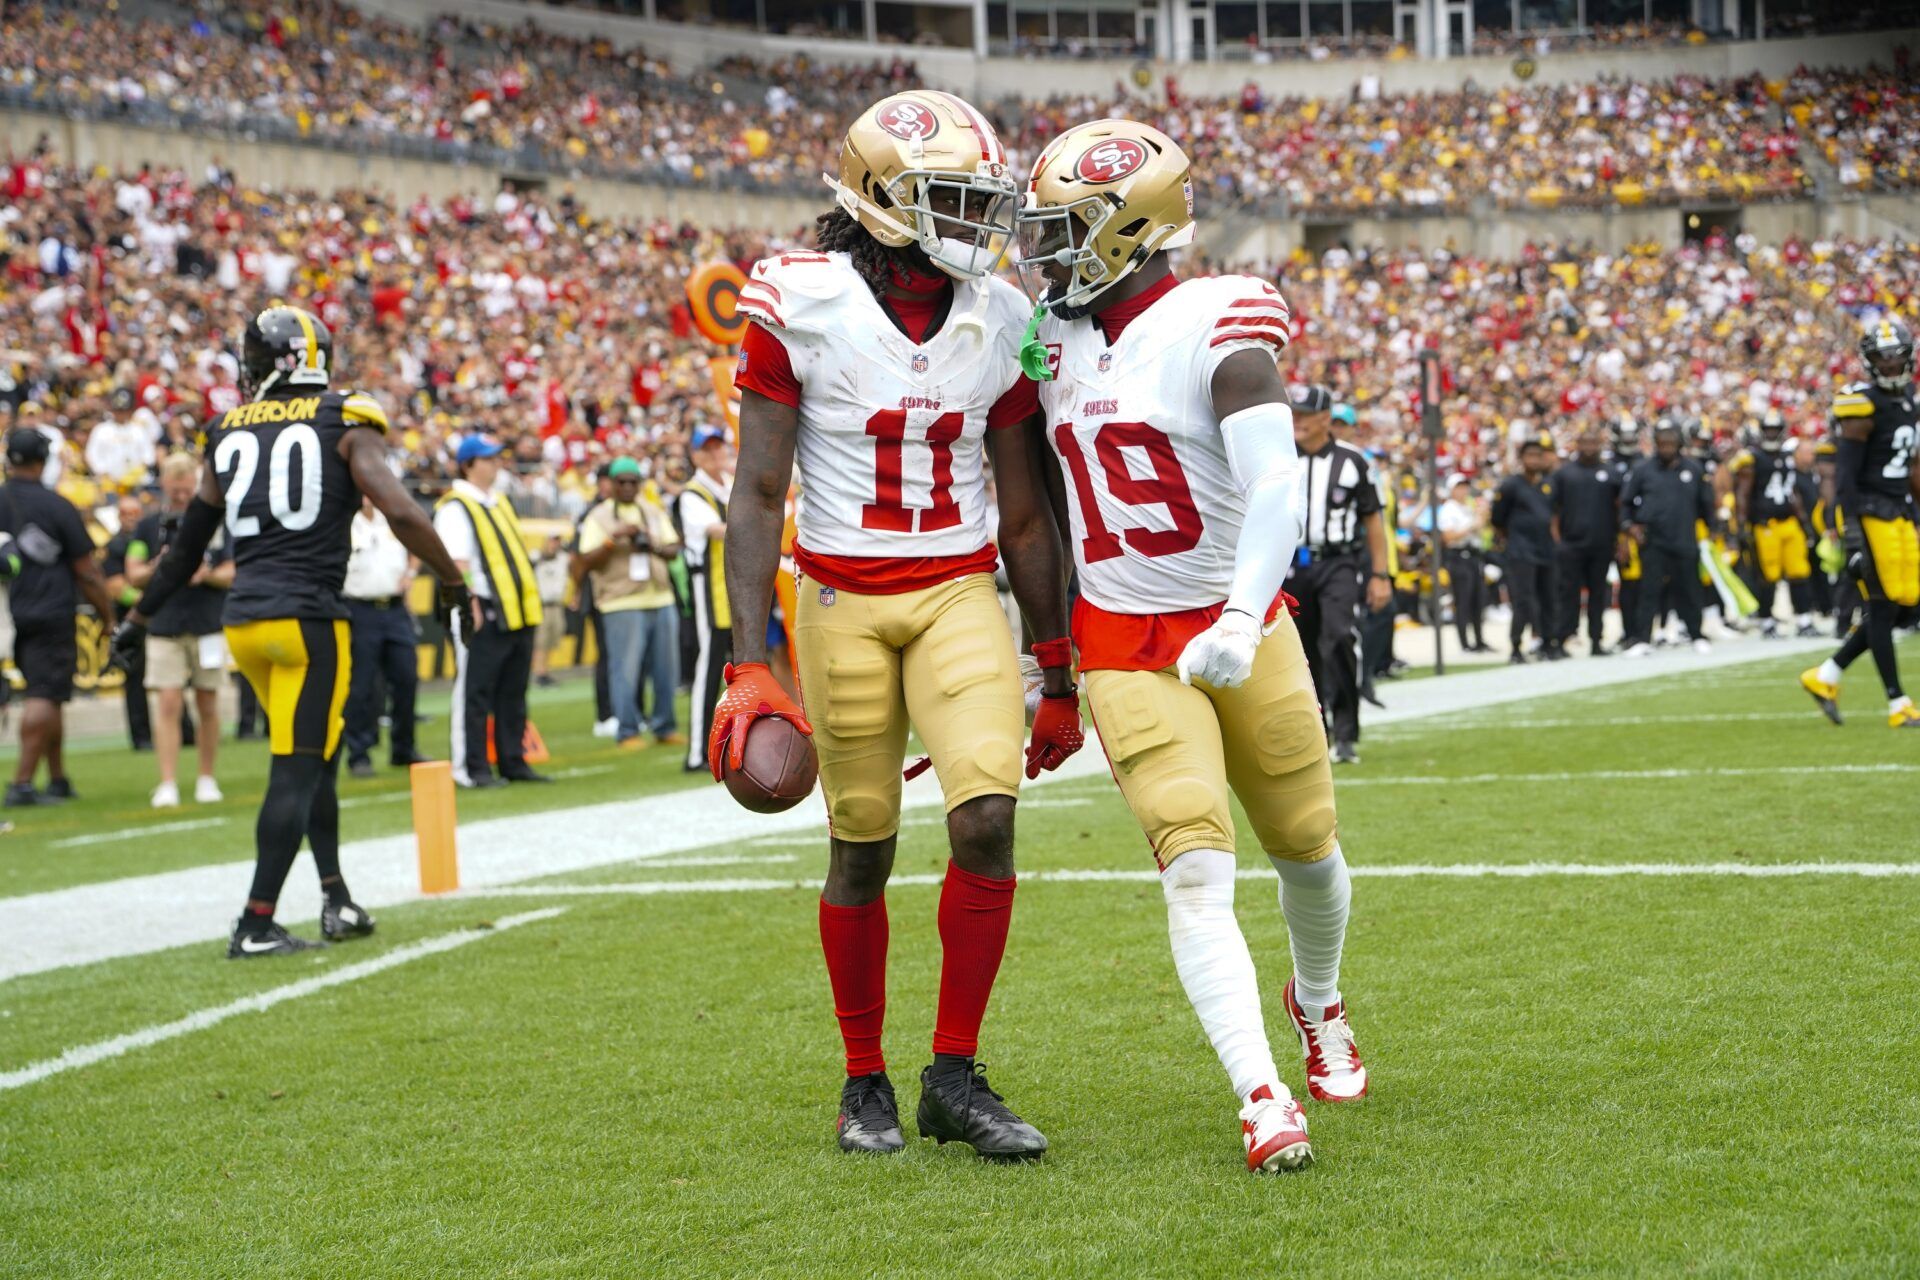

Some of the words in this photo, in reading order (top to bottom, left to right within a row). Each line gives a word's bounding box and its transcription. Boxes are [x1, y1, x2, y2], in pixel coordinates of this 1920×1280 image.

[221, 397, 320, 429] PETERSON
[862, 408, 964, 533] 11
[214, 422, 322, 538] 20
[1054, 421, 1205, 565] 19
